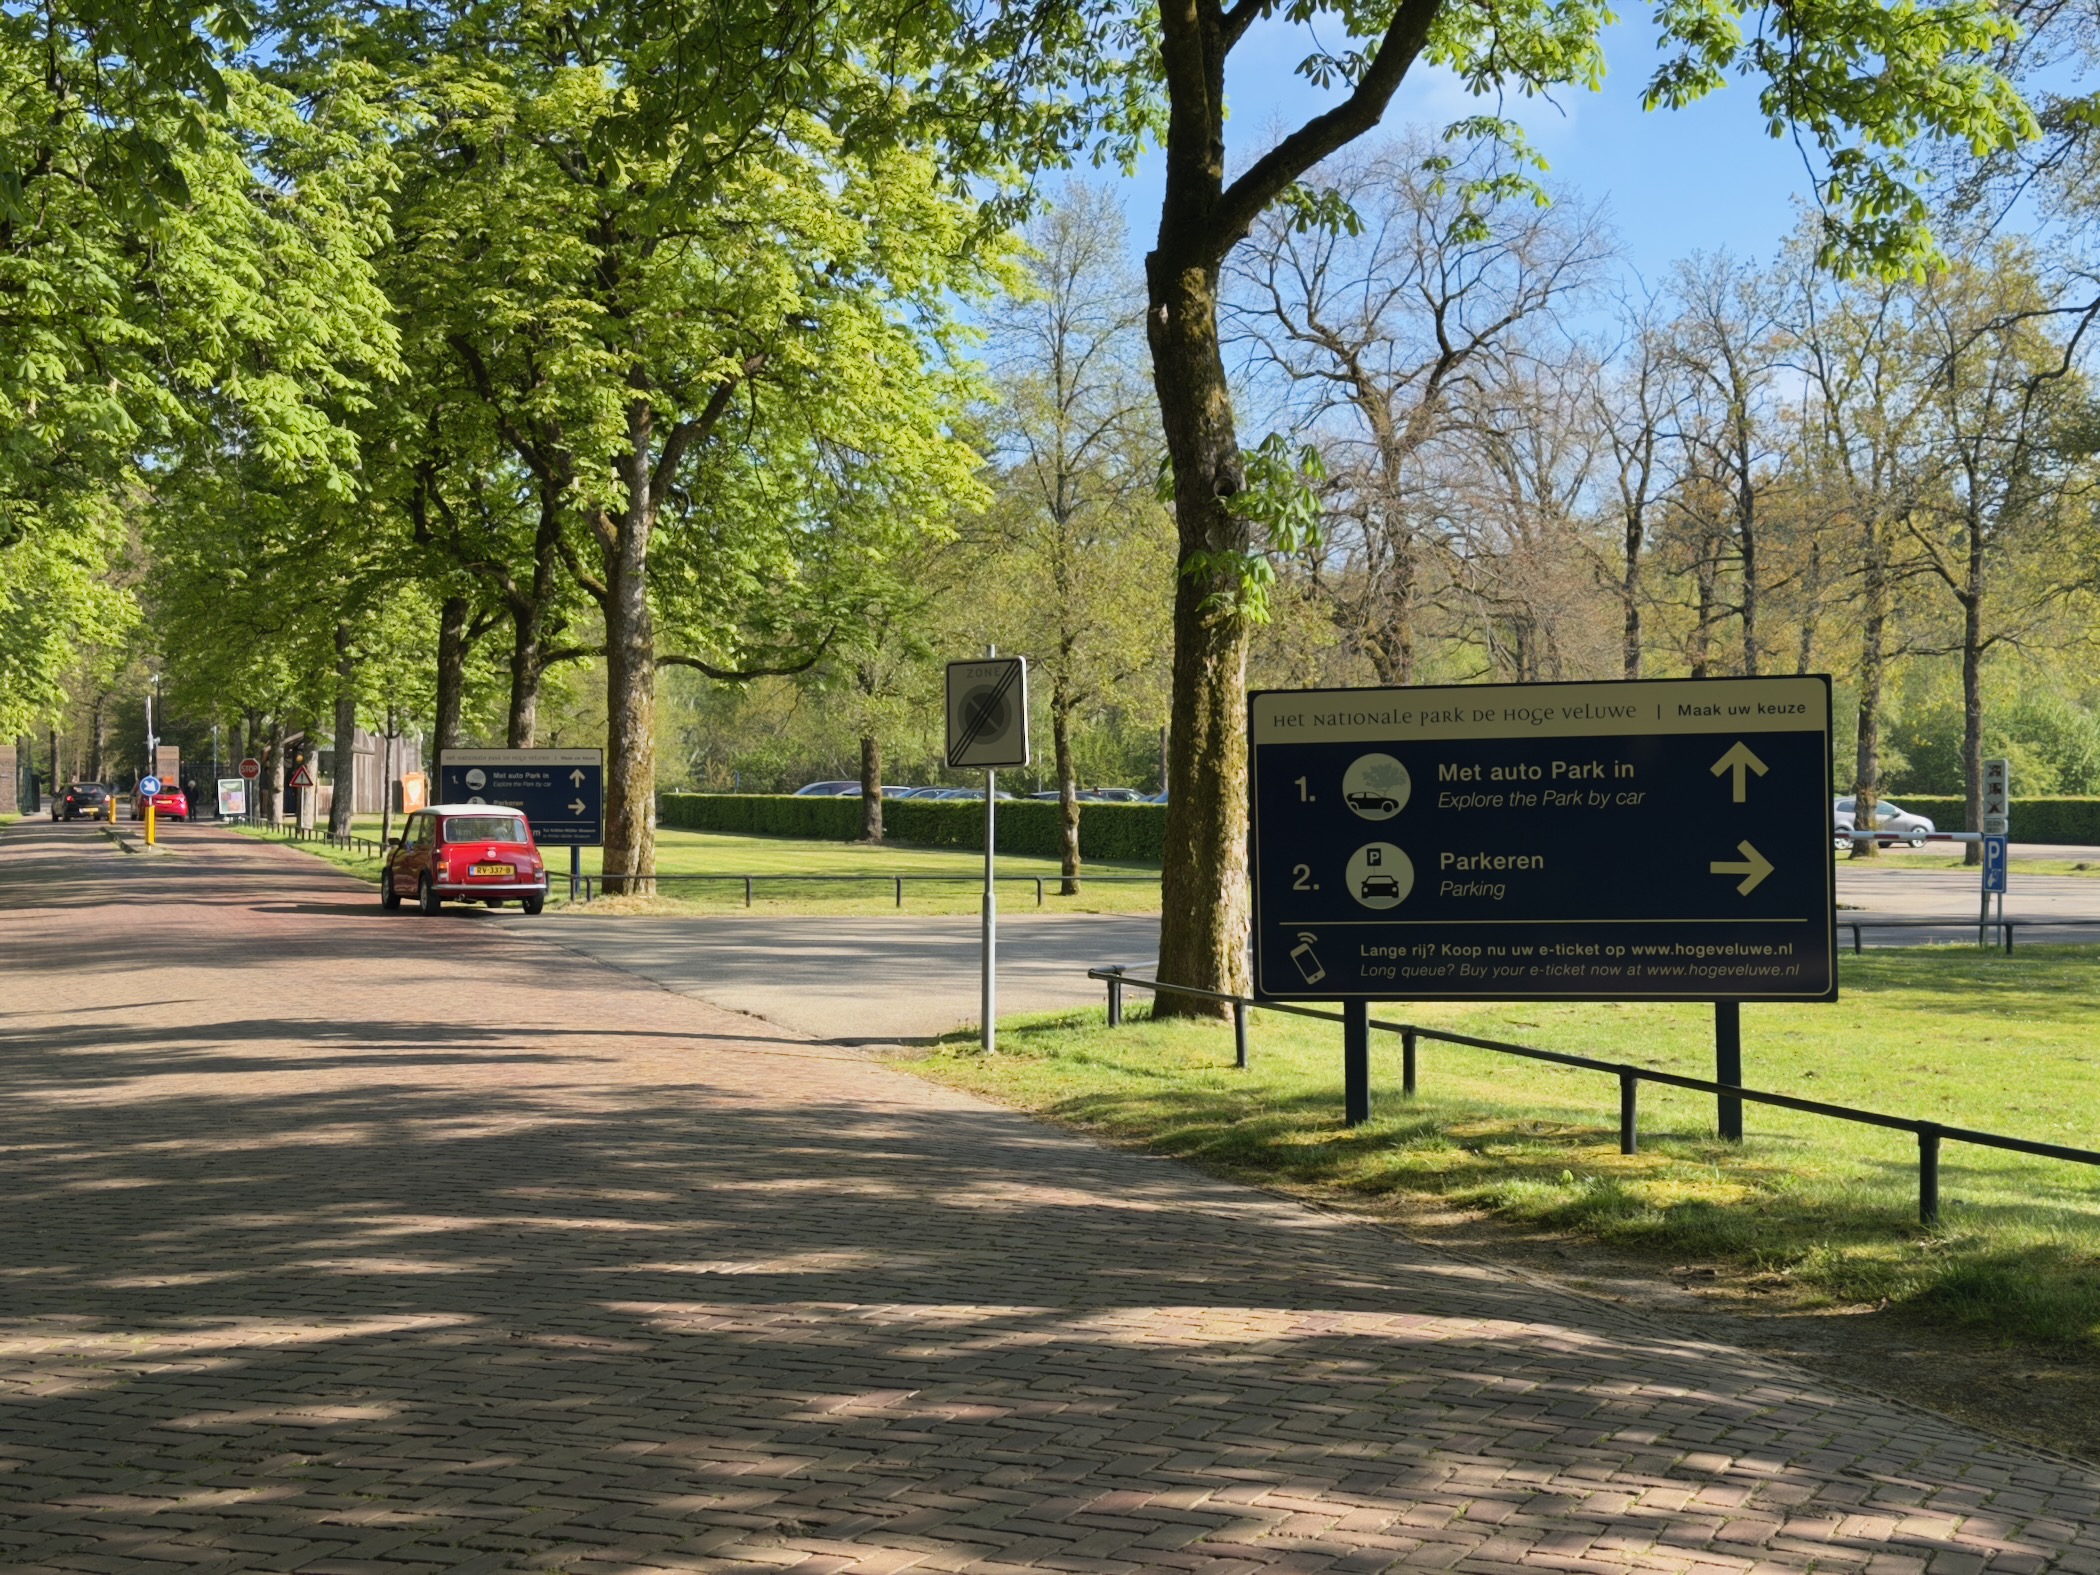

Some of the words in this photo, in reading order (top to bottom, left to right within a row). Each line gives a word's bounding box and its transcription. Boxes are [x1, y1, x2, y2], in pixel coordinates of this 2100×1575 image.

[967, 667, 1000, 679] ZONE
[1677, 703, 1722, 717] Maak
[1728, 705, 1751, 716] uw
[1757, 701, 1806, 715] keuze
[240, 765, 258, 773] STOP
[1438, 764, 1482, 782] Met
[1490, 762, 1542, 781] auto
[1551, 761, 1606, 780] Park
[1614, 760, 1635, 779] in
[1294, 775, 1316, 803] 1.
[1438, 791, 1504, 811] Explore
[1509, 790, 1538, 807] the
[1542, 789, 1584, 807] Park
[1588, 790, 1612, 809] by
[1615, 791, 1646, 806] car
[1440, 852, 1545, 871] Parkeren
[1988, 840, 2000, 869] P
[1292, 863, 1321, 891] 2.
[1439, 880, 1507, 901] Parking
[1360, 944, 1407, 960] Lange
[1412, 943, 1436, 959] rij?
[1441, 943, 1482, 959] Koop
[1487, 945, 1506, 956] nu
[1511, 945, 1534, 956] uw
[1539, 942, 1600, 956] e-ticket
[1605, 945, 1626, 959] op
[1631, 942, 1793, 959] www.hogeveluwe.nl
[1359, 963, 1397, 979] Long
[1401, 963, 1455, 979] queue?
[1459, 963, 1489, 979] Buy
[1492, 965, 1525, 979] your
[1529, 962, 1587, 977] e-ticket
[1590, 965, 1622, 977] now
[1626, 964, 1643, 976] at
[1647, 962, 1800, 979] www.hogeveluwe.nl
